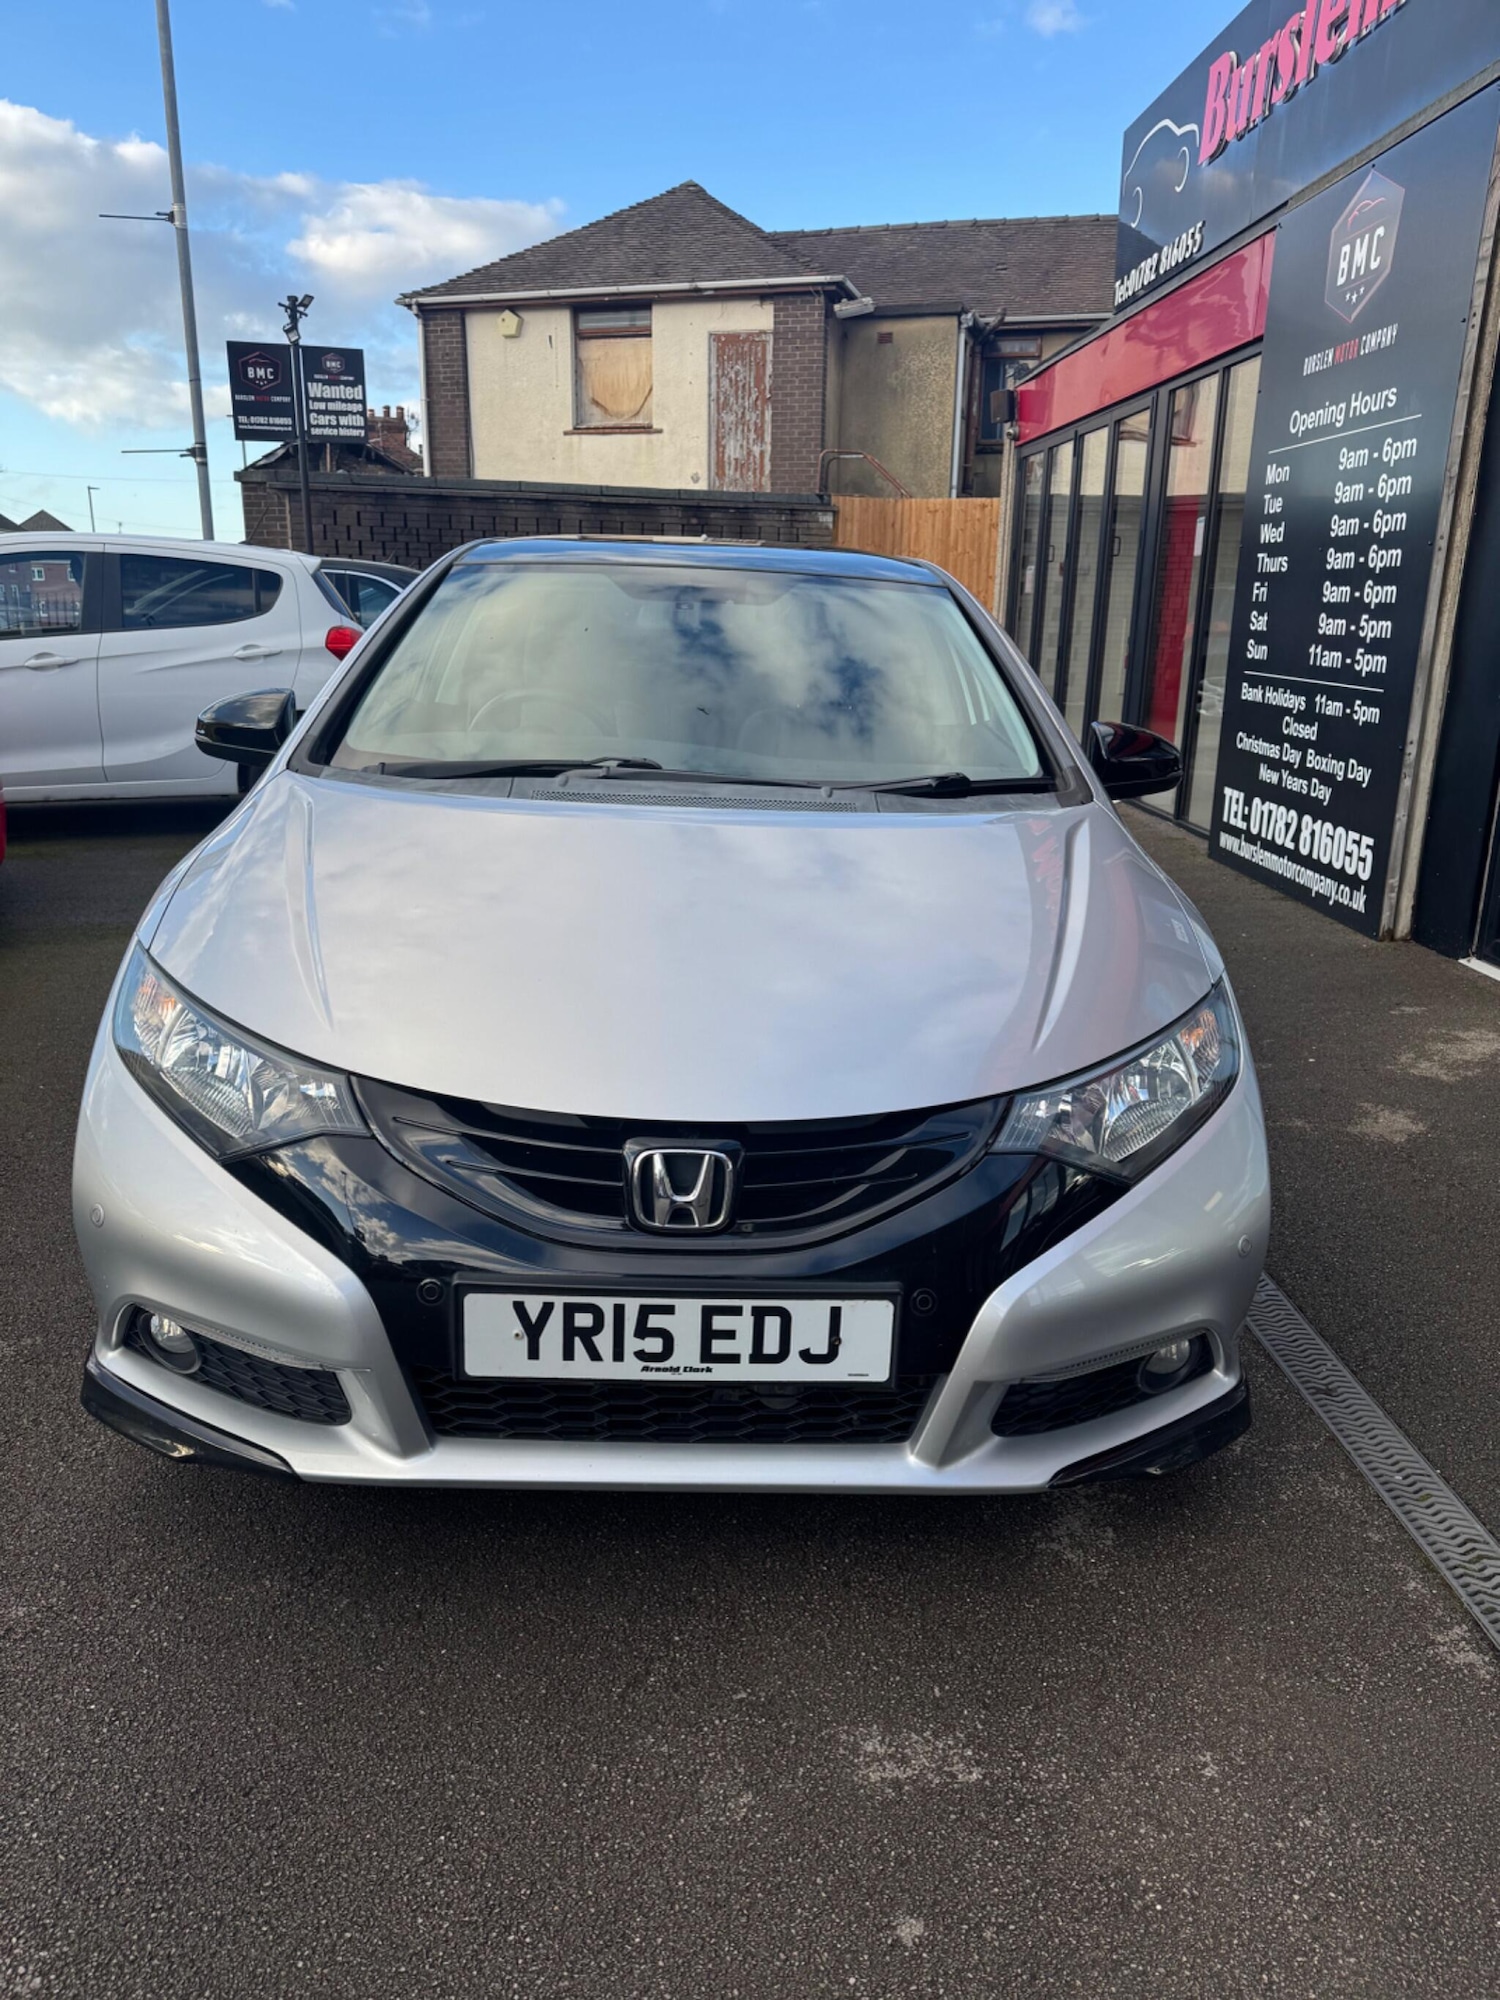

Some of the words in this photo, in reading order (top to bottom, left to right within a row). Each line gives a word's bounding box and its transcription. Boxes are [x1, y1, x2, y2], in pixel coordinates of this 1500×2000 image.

[1160, 220, 1204, 275] 816055
[1336, 225, 1385, 286] BMC
[247, 366, 274, 379] BMC
[307, 382, 364, 400] Wanted
[308, 400, 326, 410] Low
[327, 401, 364, 413] mileage
[310, 412, 337, 426] Cars
[338, 414, 365, 427] with
[1289, 401, 1346, 438] Opening
[1349, 387, 1397, 418] Hours
[310, 427, 338, 436] service
[338, 428, 365, 438] history
[1265, 463, 1290, 485] Mon
[1338, 447, 1369, 471] 9am
[1382, 437, 1417, 467] 6pm
[1263, 494, 1283, 515] Tue
[1334, 481, 1364, 504] 9am
[1377, 473, 1412, 503] 6pm
[1260, 521, 1285, 544] Wed
[1330, 514, 1360, 537] 9am
[1373, 509, 1407, 539] 6pm
[1257, 552, 1288, 573] Thurs
[1325, 547, 1355, 570] 9am
[1368, 544, 1402, 574] 6pm
[1252, 582, 1268, 602] Fri
[1322, 580, 1351, 603] 9am
[1363, 579, 1397, 609] 6pm
[1250, 610, 1268, 631] Sat
[1318, 612, 1346, 636] 9am
[1359, 614, 1392, 644] 5pm
[1246, 638, 1268, 660] Sun
[1309, 644, 1342, 669] 11am
[1354, 648, 1387, 677] 5pm
[1241, 682, 1264, 703] Bank
[1264, 686, 1306, 714] Holidays
[1315, 693, 1344, 717] 11am
[1353, 700, 1381, 726] 5pm
[1282, 716, 1318, 741] Closed
[1236, 731, 1281, 760] Christmas
[1282, 743, 1302, 769] Day
[1306, 748, 1345, 782] Boxing
[1347, 758, 1372, 788] Day
[1259, 763, 1280, 785] New
[1281, 768, 1309, 795] Years
[1310, 778, 1333, 806] Day
[1222, 786, 1249, 830] TEL:
[1250, 797, 1299, 850] 01782
[1299, 814, 1375, 881] 816055
[1219, 831, 1367, 914] www.burslemmotorcompany.co.uk
[512, 1301, 676, 1363] YR15
[700, 1305, 842, 1364] EDJ
[640, 1365, 681, 1373] Arnold
